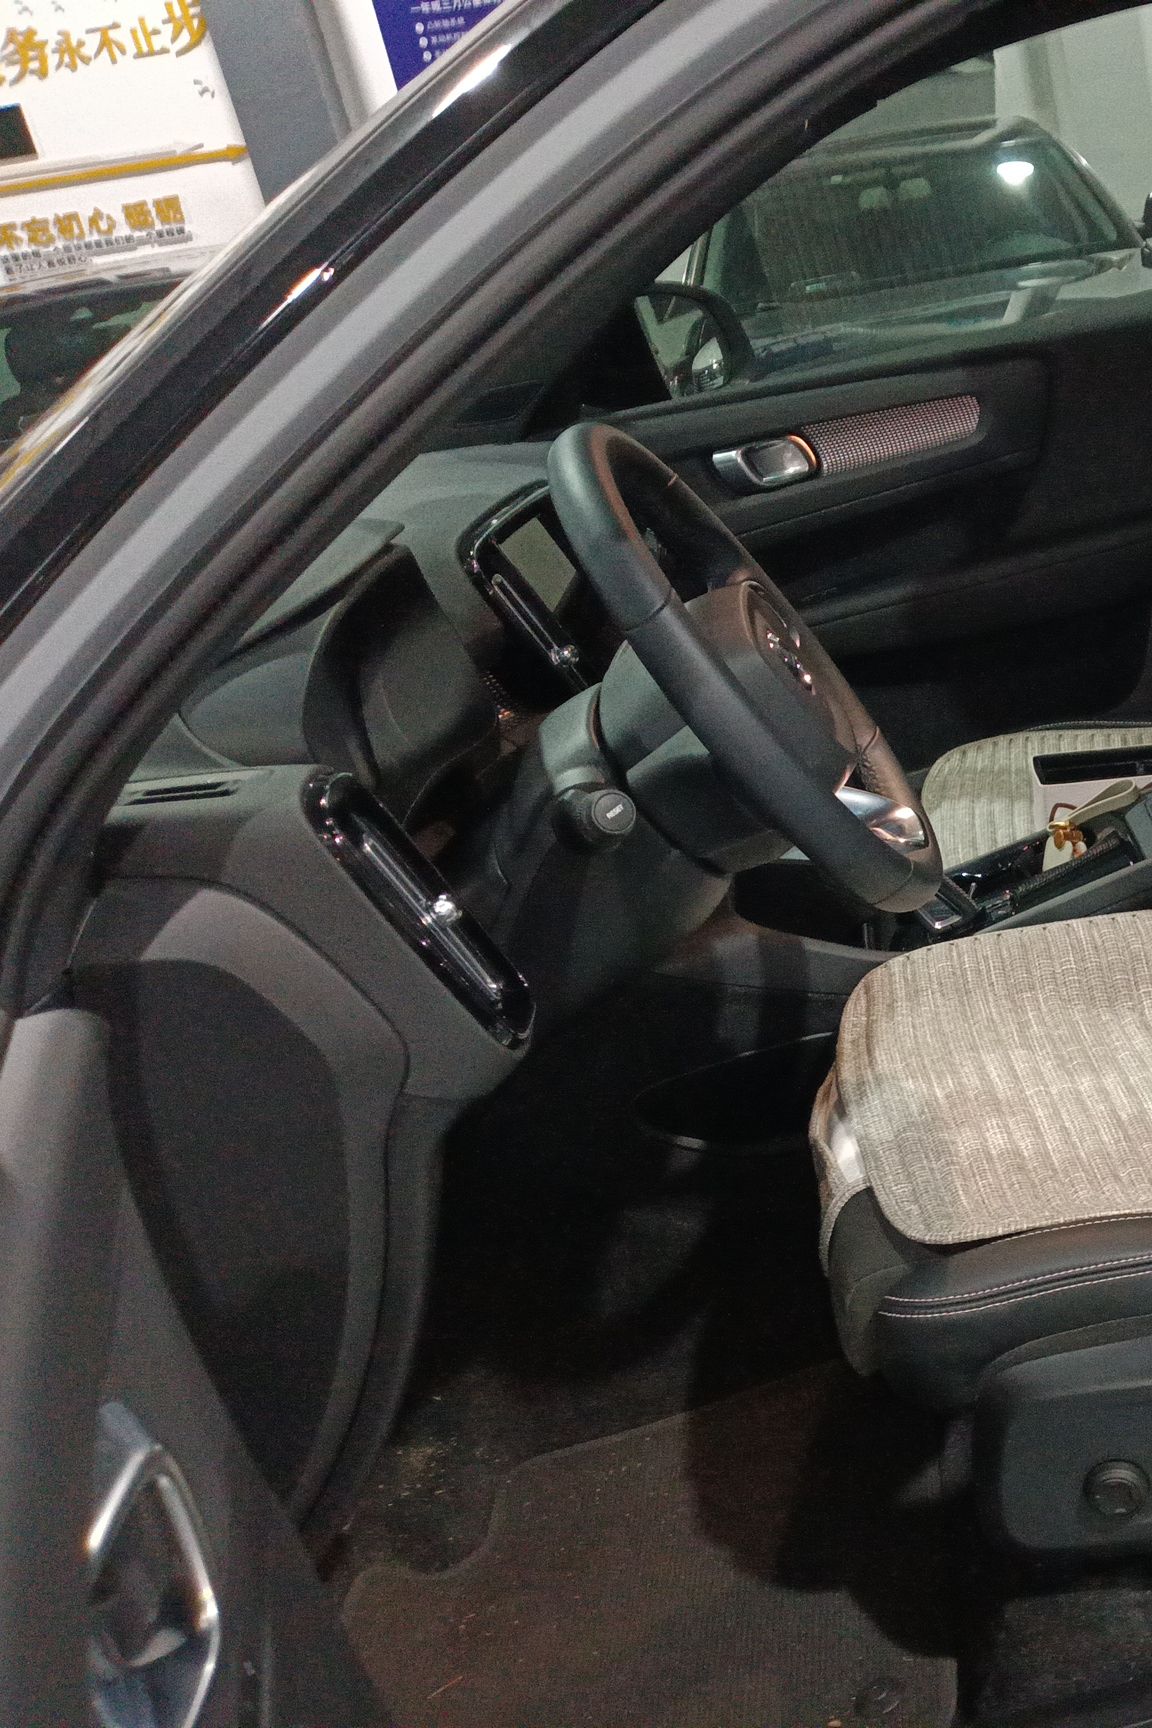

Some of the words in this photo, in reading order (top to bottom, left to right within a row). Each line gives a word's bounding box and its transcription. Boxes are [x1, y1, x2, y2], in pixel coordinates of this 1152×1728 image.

[0, 0, 208, 87] 务永不止步
[606, 803, 624, 820] RESET
